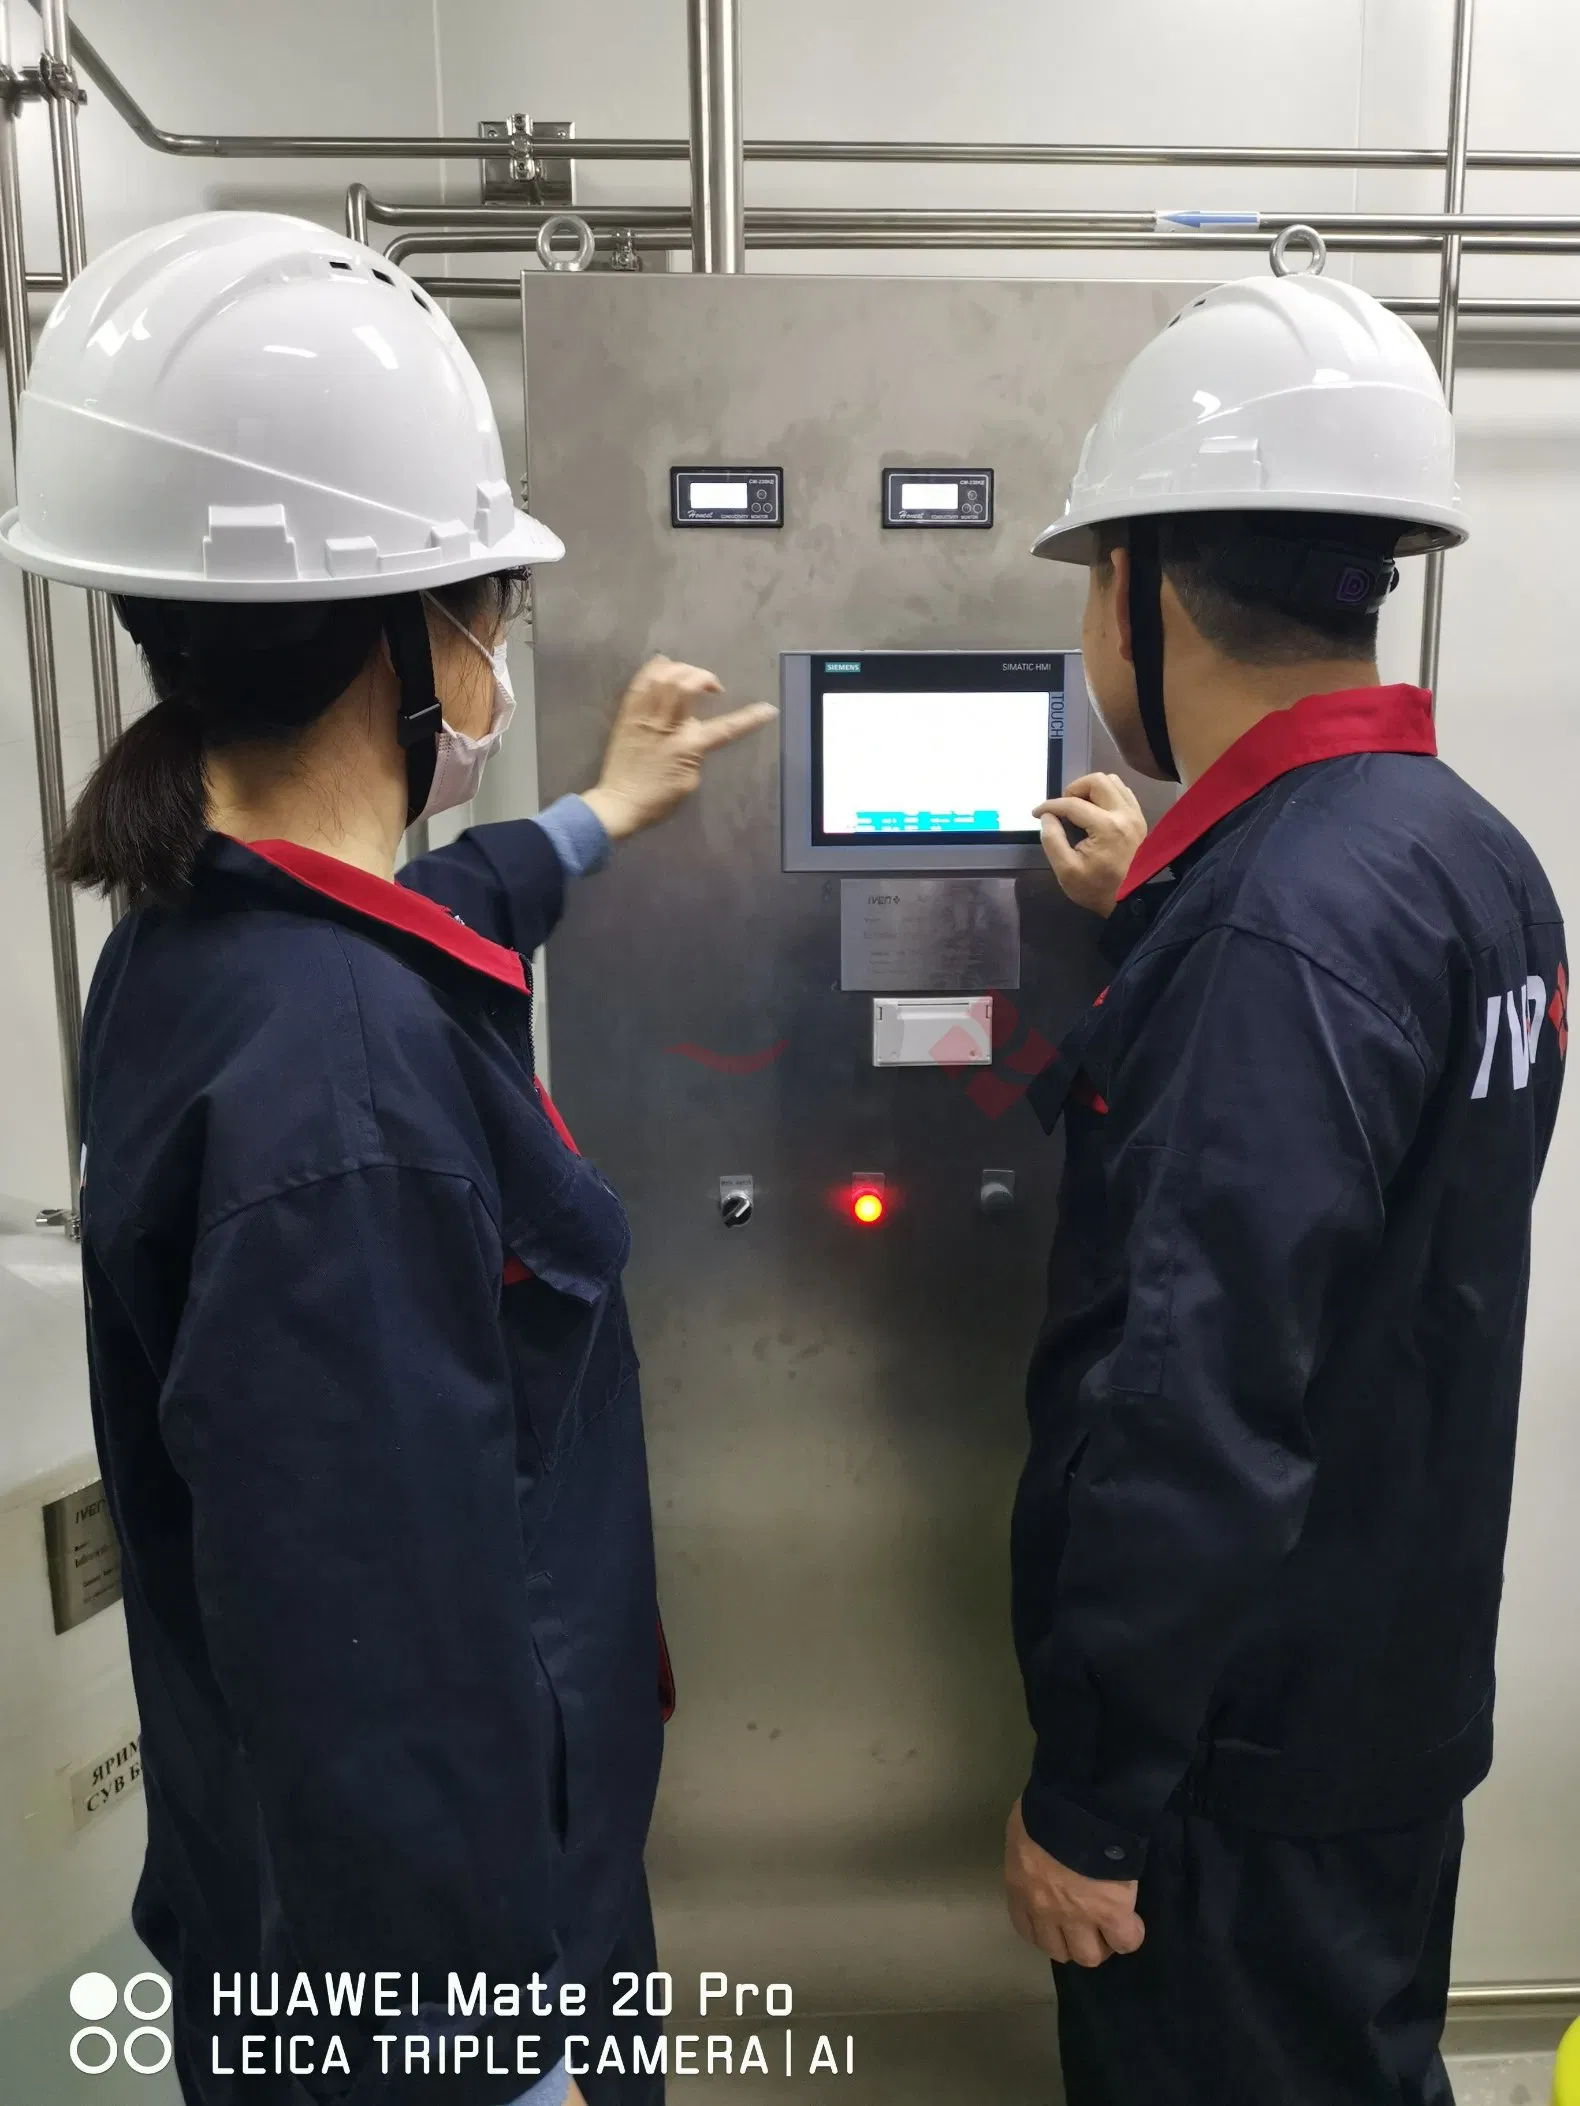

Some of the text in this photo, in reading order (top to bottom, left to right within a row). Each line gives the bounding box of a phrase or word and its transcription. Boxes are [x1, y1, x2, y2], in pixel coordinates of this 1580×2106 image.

[1002, 663, 1052, 671] SIMATIC HMI
[1051, 693, 1065, 738] TOUCH
[86, 1776, 125, 1812] СУВ
